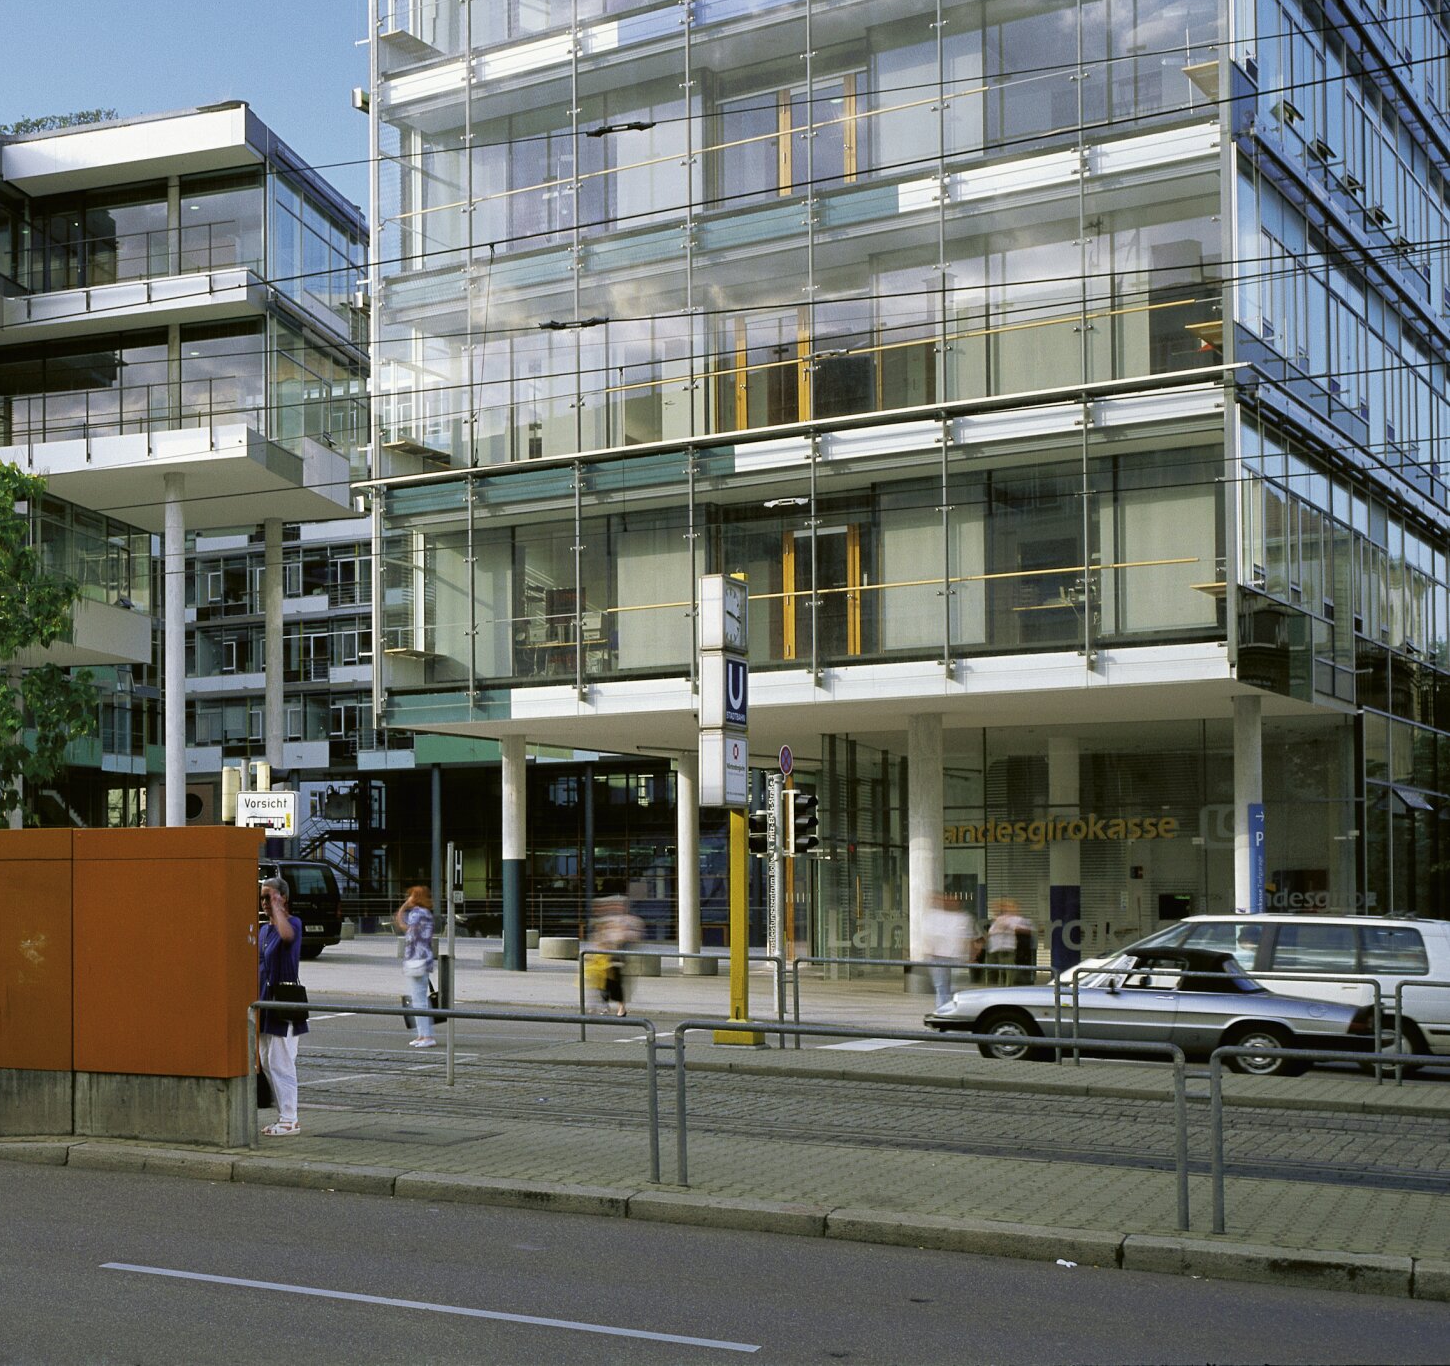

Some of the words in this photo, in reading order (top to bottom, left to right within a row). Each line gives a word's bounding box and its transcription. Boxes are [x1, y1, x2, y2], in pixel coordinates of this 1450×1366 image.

[728, 663, 743, 710] U
[726, 711, 745, 723] STADTBAHN
[244, 798, 287, 809] Vorsicht
[943, 814, 1176, 851] andesgirokasse
[1256, 832, 1263, 846] P
[455, 850, 462, 884] H
